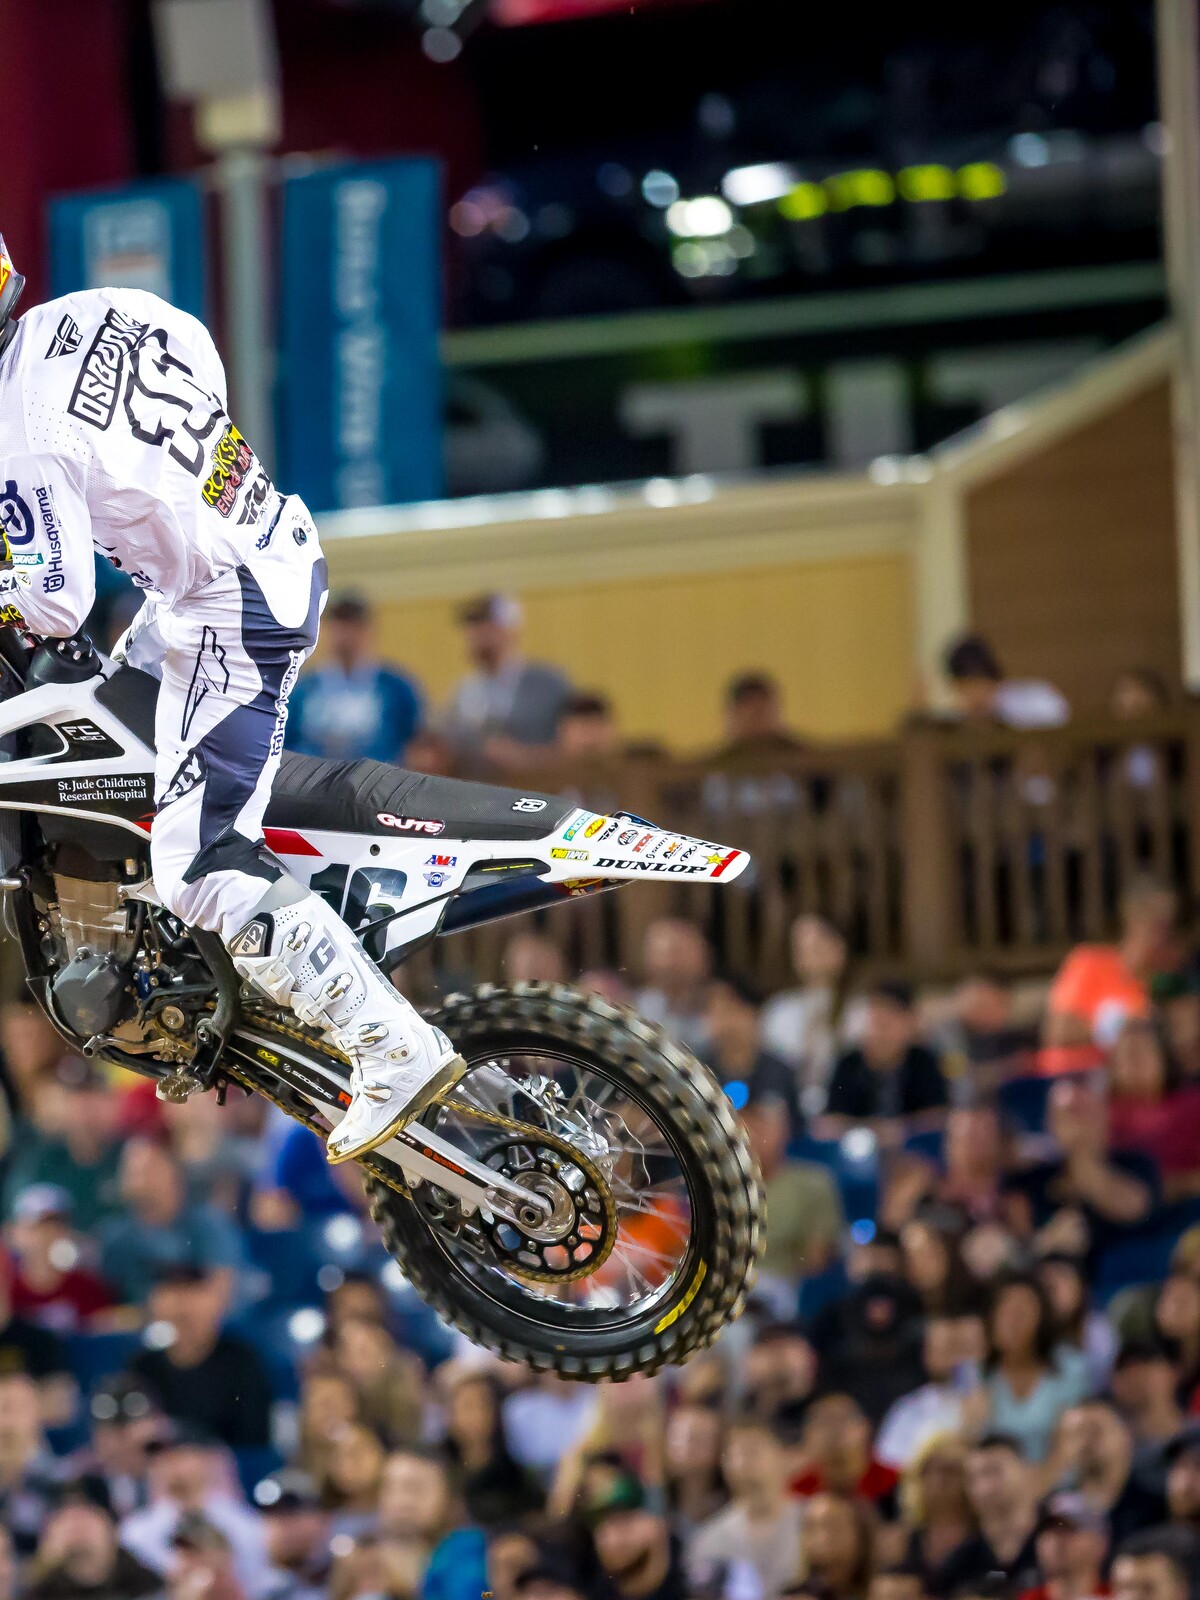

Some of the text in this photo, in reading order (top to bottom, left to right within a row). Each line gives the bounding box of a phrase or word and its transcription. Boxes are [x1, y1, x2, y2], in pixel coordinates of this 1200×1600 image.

[35, 486, 63, 574] Husqvarna
[61, 725, 100, 736] FC
[58, 777, 146, 792] St. Jude Children's
[59, 788, 147, 802] Research Hospital
[376, 813, 443, 834] GUTS
[424, 854, 458, 866] AMA
[593, 858, 708, 874] DUNLOP
